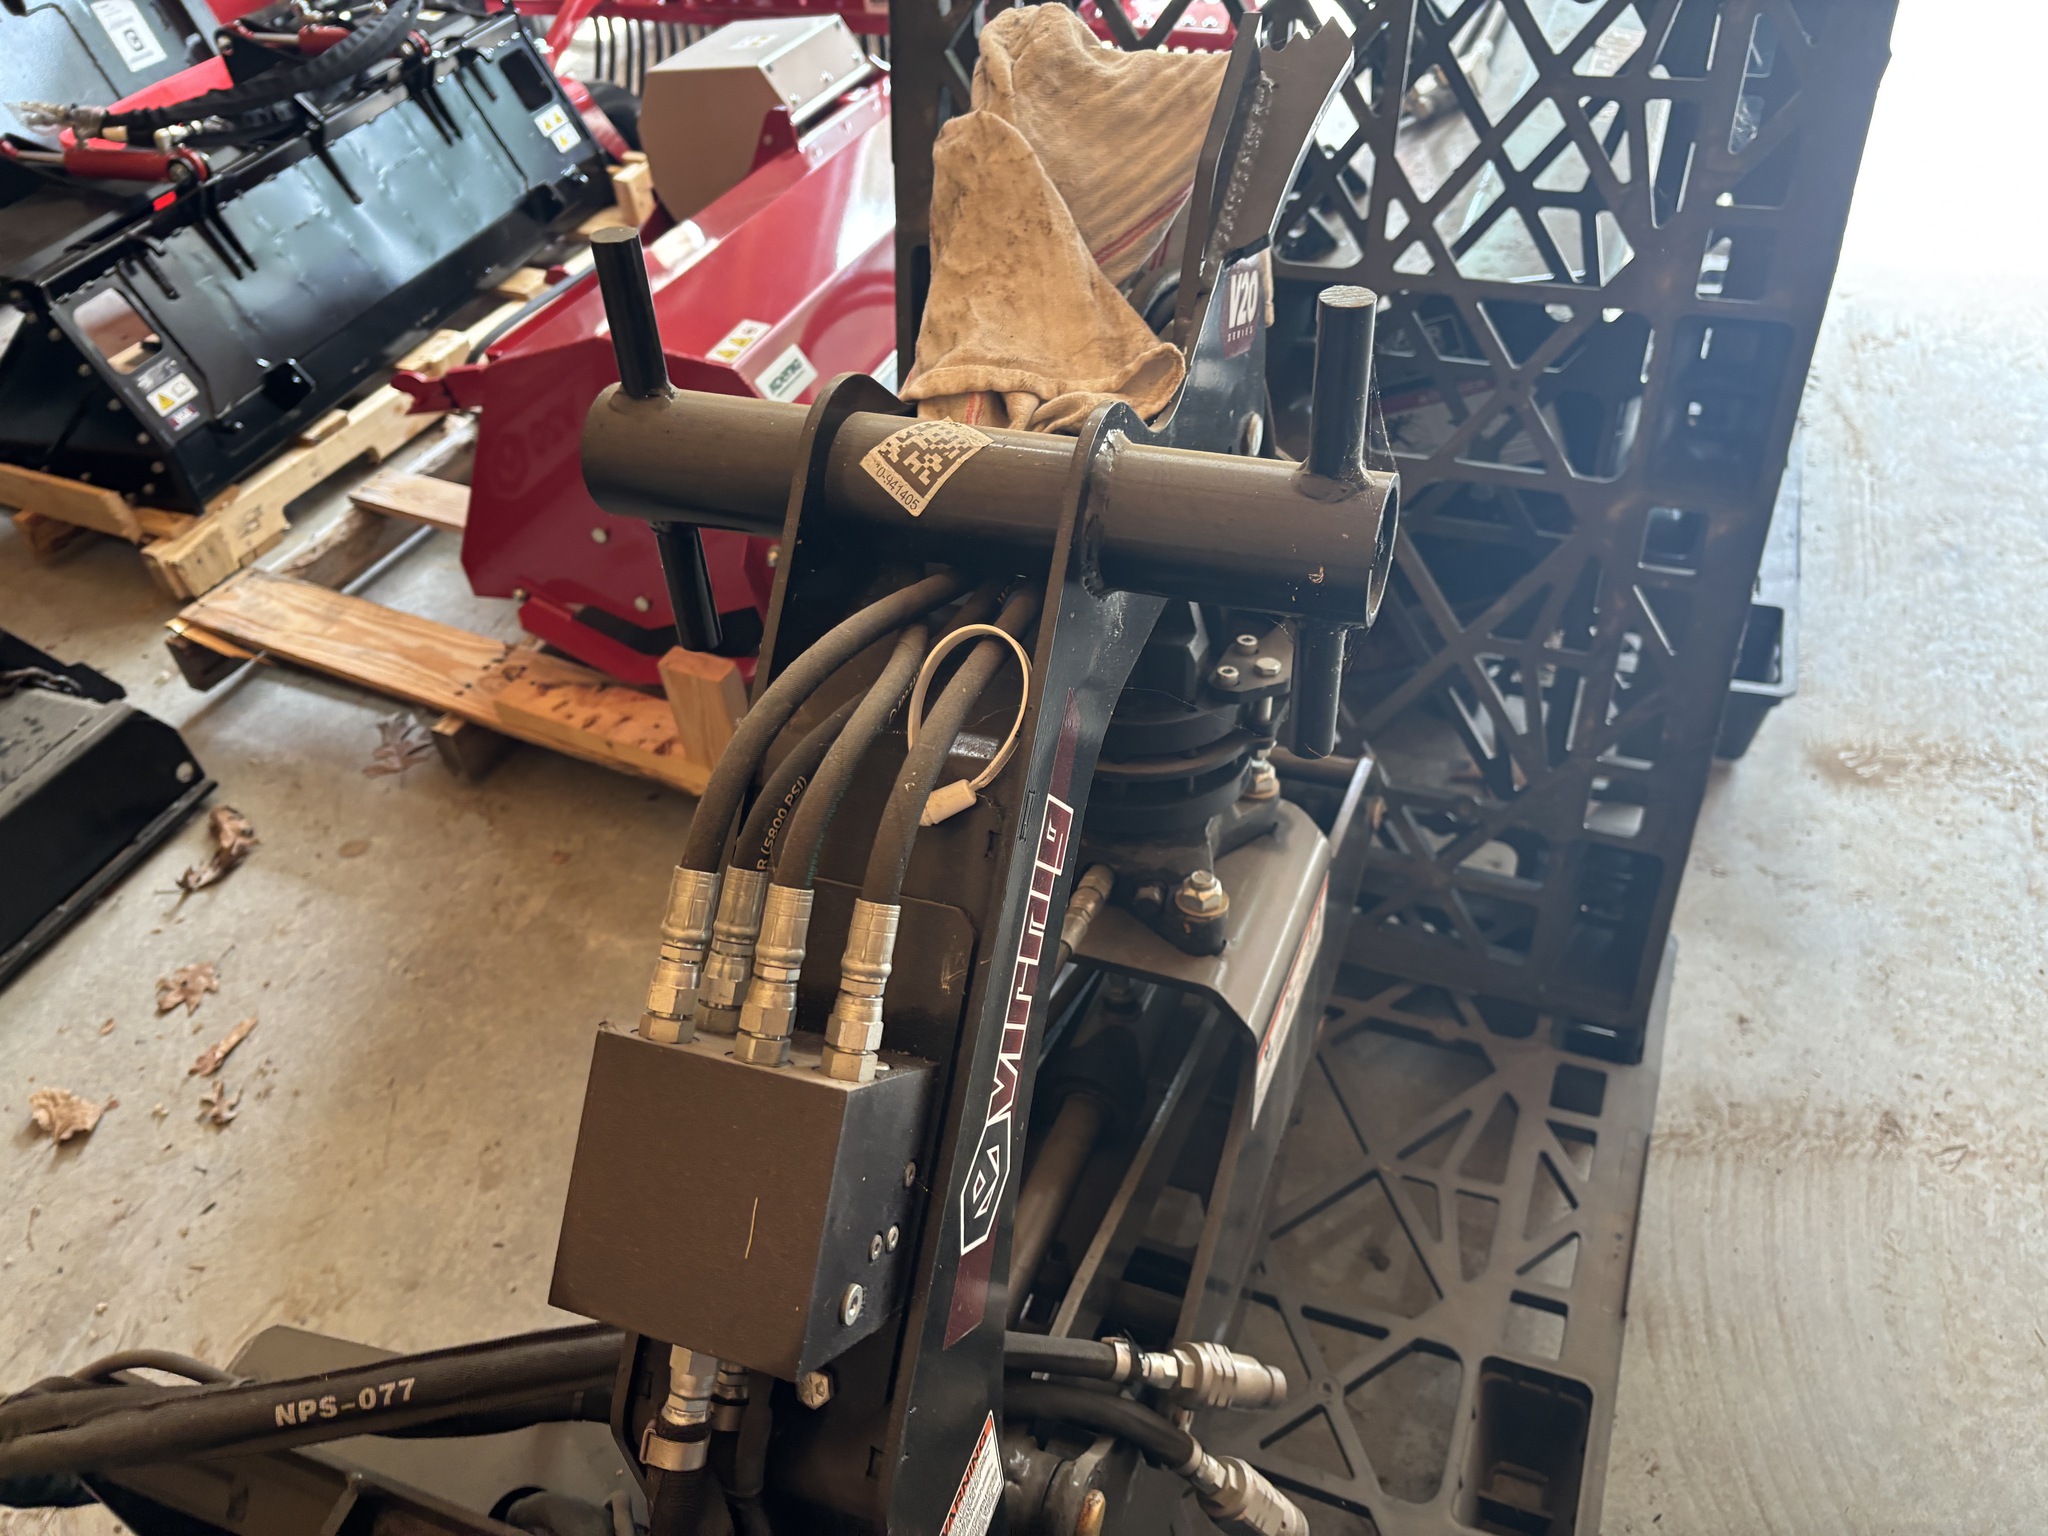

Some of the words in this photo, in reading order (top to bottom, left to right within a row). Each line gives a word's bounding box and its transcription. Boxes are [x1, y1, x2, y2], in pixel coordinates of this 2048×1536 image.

[1228, 270, 1259, 329] V20
[1227, 325, 1254, 342] SERIES
[761, 807, 788, 855] (5800
[784, 775, 807, 807] PSI)
[275, 1377, 415, 1427] NPS-077
